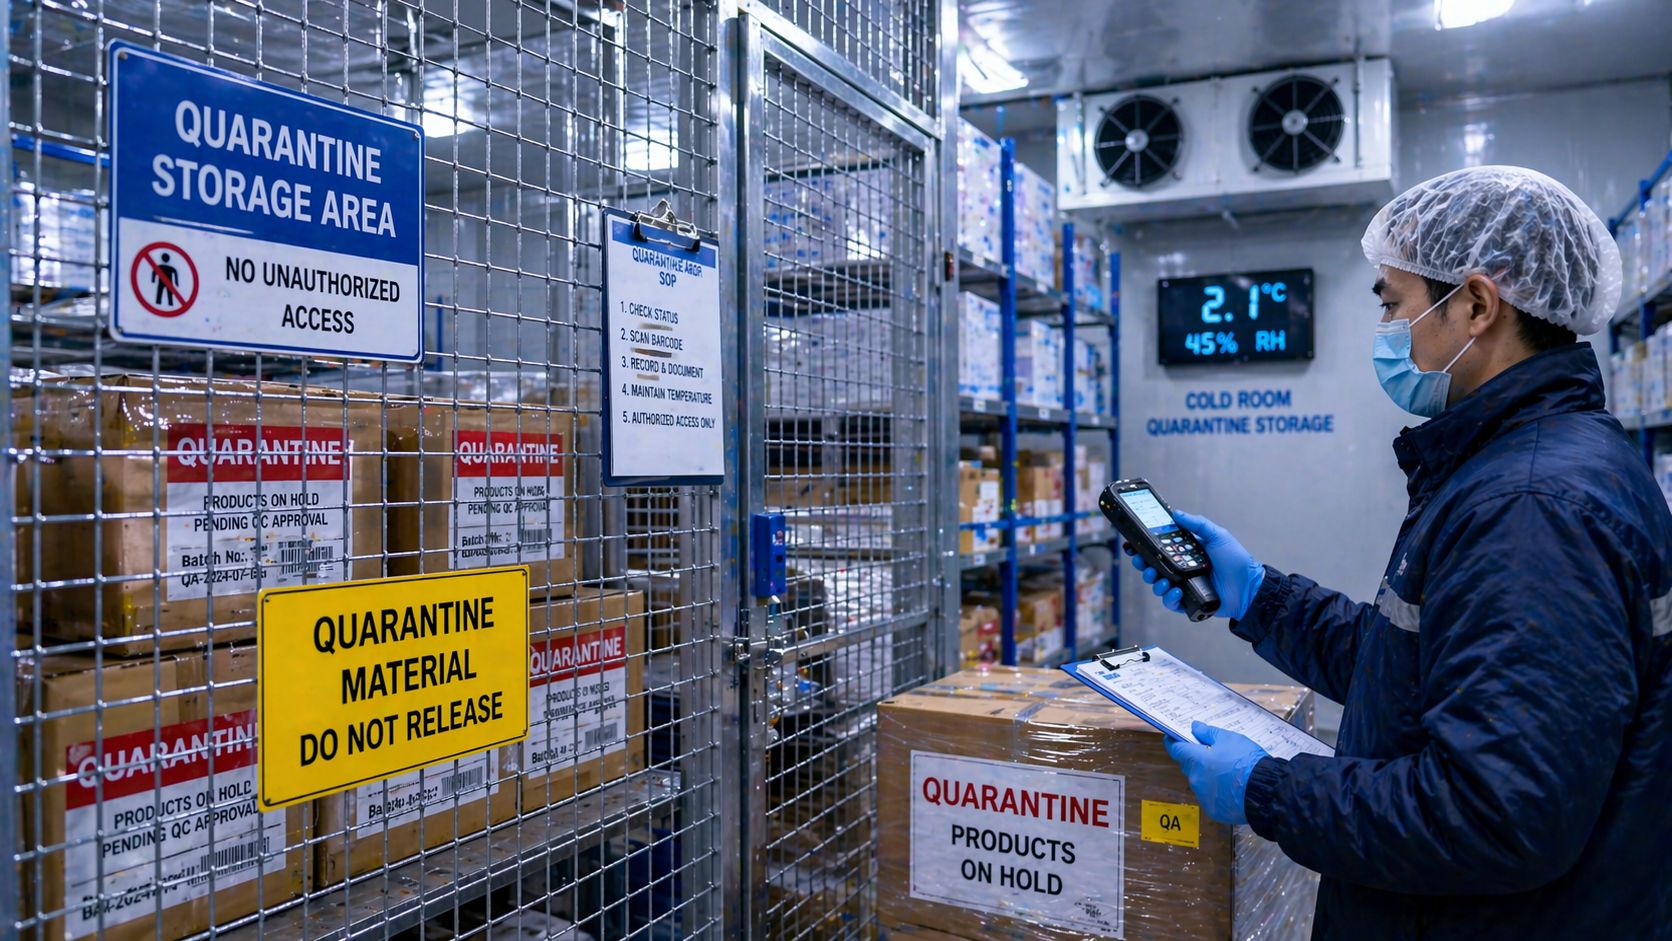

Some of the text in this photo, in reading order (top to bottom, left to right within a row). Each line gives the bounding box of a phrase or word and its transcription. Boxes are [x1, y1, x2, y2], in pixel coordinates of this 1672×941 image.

[175, 100, 382, 184] QUARANTINE
[152, 154, 396, 238] STORAGE AREA
[225, 256, 400, 303] NO UNAUTHORIZED
[659, 271, 677, 288] SOP
[281, 304, 355, 334] ACCESS
[620, 301, 679, 325] 1. CHECK STATUS
[620, 327, 683, 351] 2. SCAN BARCODE
[1185, 330, 1286, 355] 45% RH
[621, 355, 704, 379] 3. RECORD & DOCUMENT
[621, 383, 712, 405] 4. MAINTAIN TEMPERATURE
[1186, 390, 1292, 410] COLD ROOM
[622, 411, 715, 429] 5. AUTHORIZED ACCESS ONLY
[1147, 415, 1334, 436] QUARANTINE STORAGE
[176, 437, 342, 468] QUARANTINE
[459, 441, 559, 465] QUARANTINE
[204, 492, 319, 511] PRODUCTS ON HOLD
[474, 486, 513, 498] PRODUCTS
[468, 503, 501, 515] PENDNG
[194, 516, 248, 532] PENDING
[272, 513, 328, 528] APPROVAL
[182, 551, 221, 568] Batch
[313, 596, 495, 654] QUARANTINE
[530, 636, 622, 675] QUARANTNE
[341, 649, 477, 705] MATERIAL
[300, 728, 338, 767] DO
[347, 714, 399, 755] NOT
[406, 691, 503, 742] RELEASE
[114, 796, 192, 830] PRODUCTS
[219, 779, 252, 802] HOLD
[922, 777, 1110, 828] QUARANTINE
[1159, 813, 1181, 831] QA
[102, 827, 167, 859] PENDING
[171, 819, 191, 839] QC
[951, 824, 1076, 865] PRODUCTS
[960, 859, 1063, 896] ON HOLD
